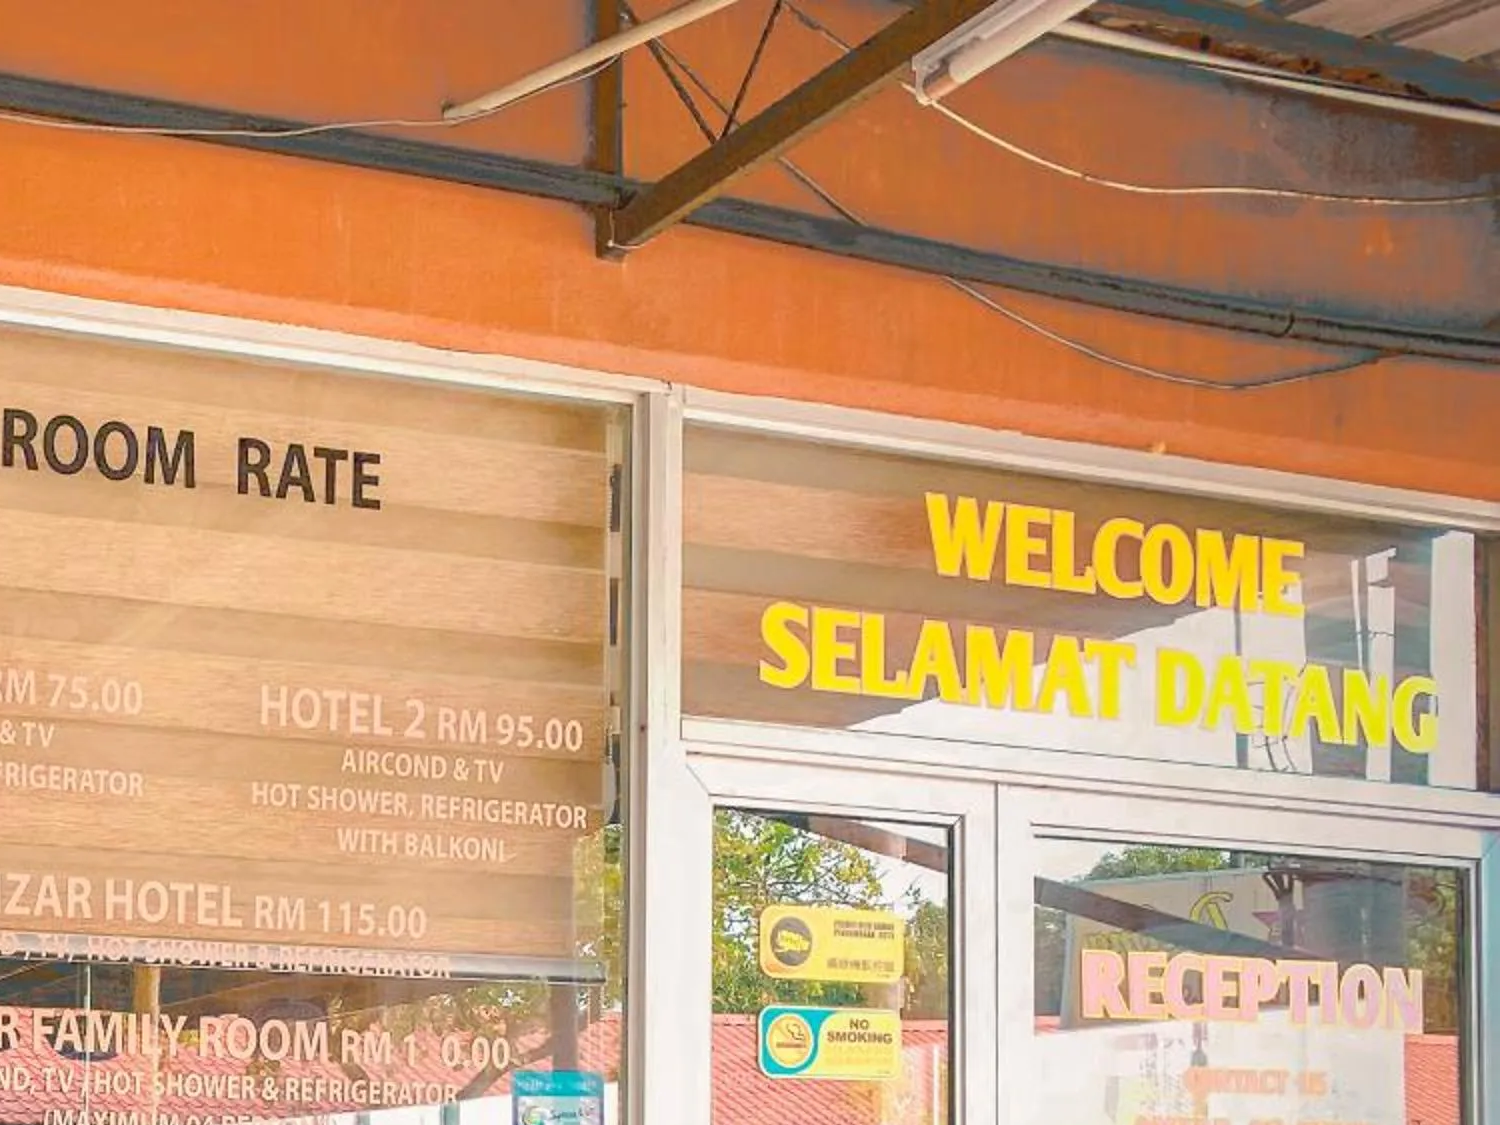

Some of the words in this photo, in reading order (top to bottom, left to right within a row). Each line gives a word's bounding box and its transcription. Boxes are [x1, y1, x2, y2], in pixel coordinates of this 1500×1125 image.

[0, 407, 197, 489] ROOM
[237, 437, 382, 511] RATE
[924, 492, 1306, 617] WELCOME
[49, 673, 144, 715] 75.00
[758, 601, 1137, 721] SELAMAT
[1156, 648, 1440, 754] DATANG
[22, 722, 56, 747] TV
[260, 685, 393, 737] HOTEL
[404, 699, 426, 739] 2
[438, 707, 487, 744] RM
[496, 714, 584, 751] 95.00
[341, 749, 448, 780] AIRCOND
[453, 758, 470, 782] &
[474, 759, 505, 784] TV
[251, 782, 302, 808] HOT
[307, 786, 414, 818] SHOWER,
[421, 794, 587, 829] REFRIGERATOR
[337, 827, 398, 855] WITH
[105, 878, 243, 928] HOTEL
[255, 895, 306, 932] RM
[318, 900, 428, 939] 115.00
[88, 936, 141, 964] HOT
[145, 937, 251, 969] SHOWER
[279, 944, 451, 979] REFRIGERATOR
[1080, 948, 1425, 1035] RECEPTION
[32, 1008, 189, 1058] FAMILY
[199, 1014, 329, 1062] ROOM
[341, 1029, 393, 1066] RM
[826, 1030, 893, 1044] SMOKING
[849, 1019, 870, 1030] NO
[94, 1071, 150, 1096] HOT
[152, 1073, 256, 1100] SHOWER
[261, 1077, 280, 1102] &
[284, 1077, 458, 1106] REFRIGERATOR
